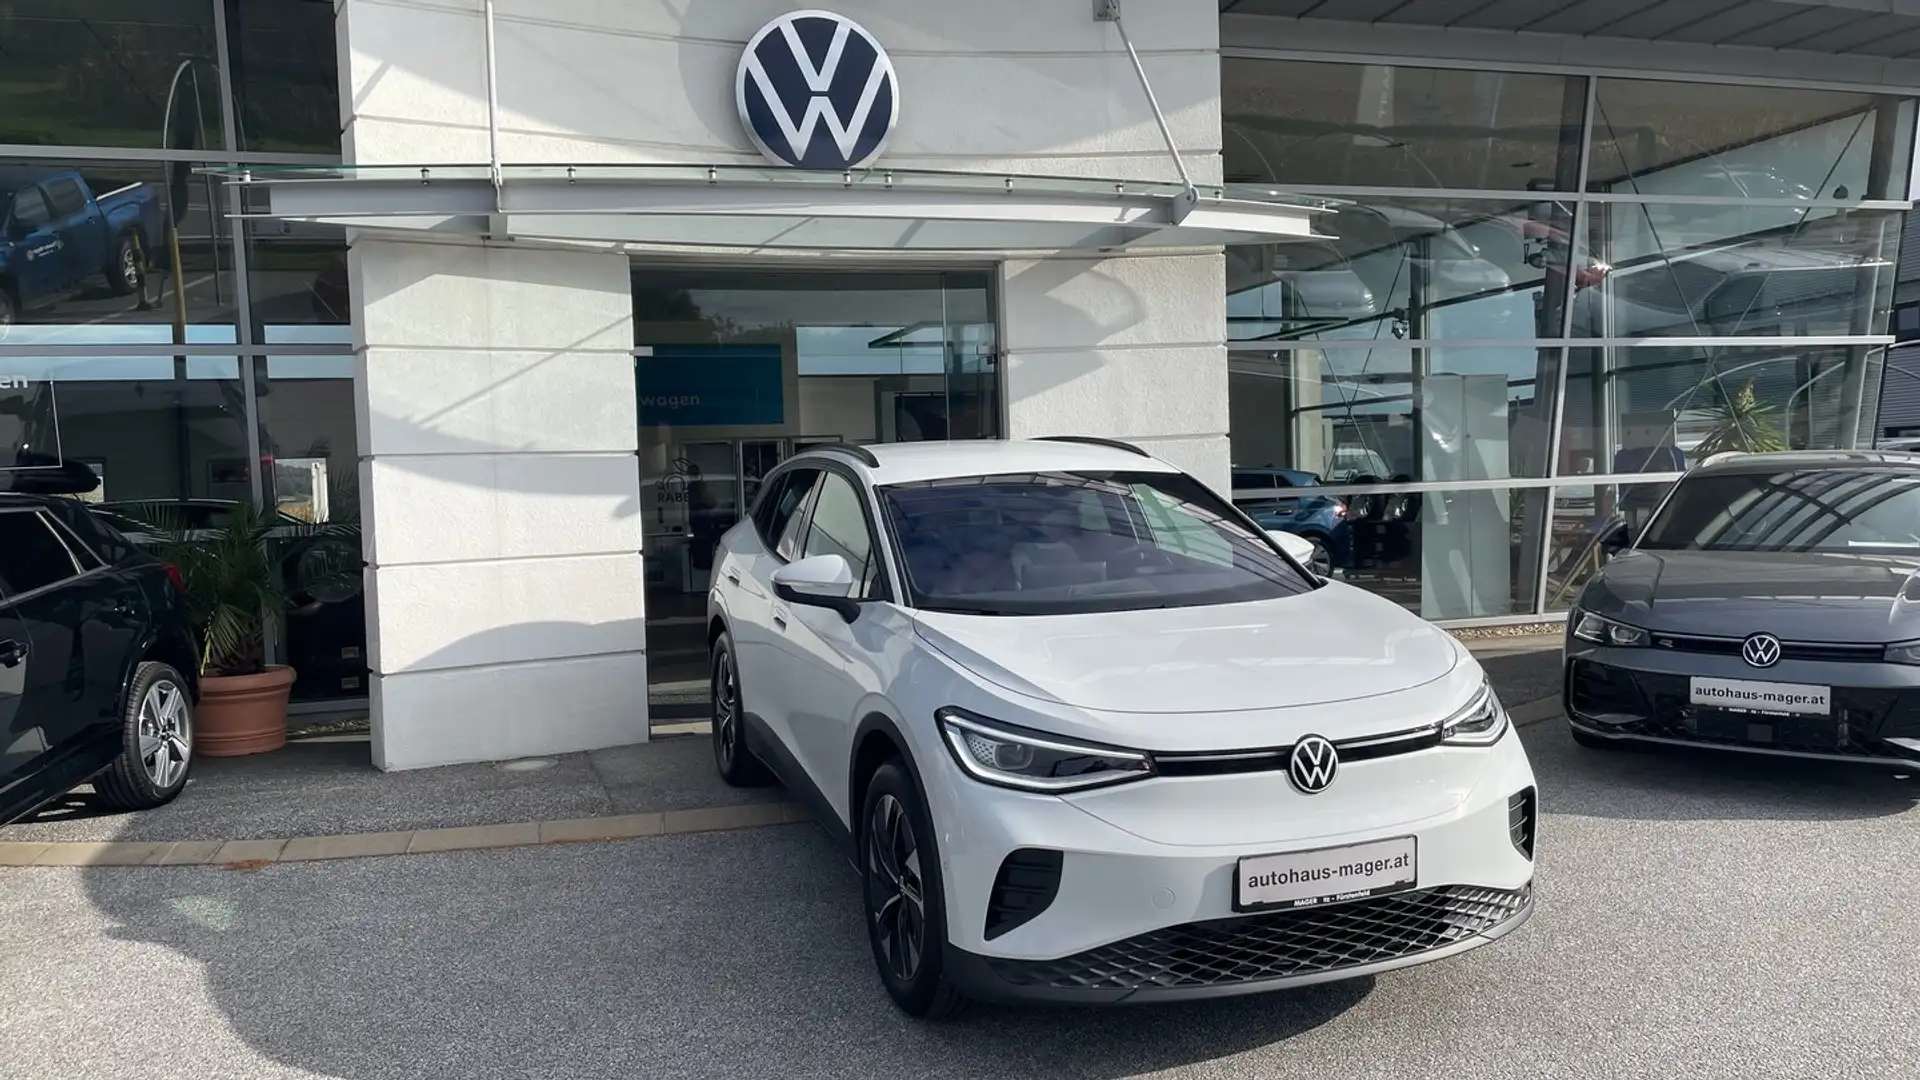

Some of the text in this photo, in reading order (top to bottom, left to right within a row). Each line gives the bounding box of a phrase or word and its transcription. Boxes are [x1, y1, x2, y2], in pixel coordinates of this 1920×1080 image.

[742, 14, 891, 162] VW
[1742, 635, 1780, 666] VW
[1695, 686, 1826, 705] autohaus-mager.at
[1293, 739, 1337, 790] VW
[1248, 853, 1409, 888] autohaus-mager.at
